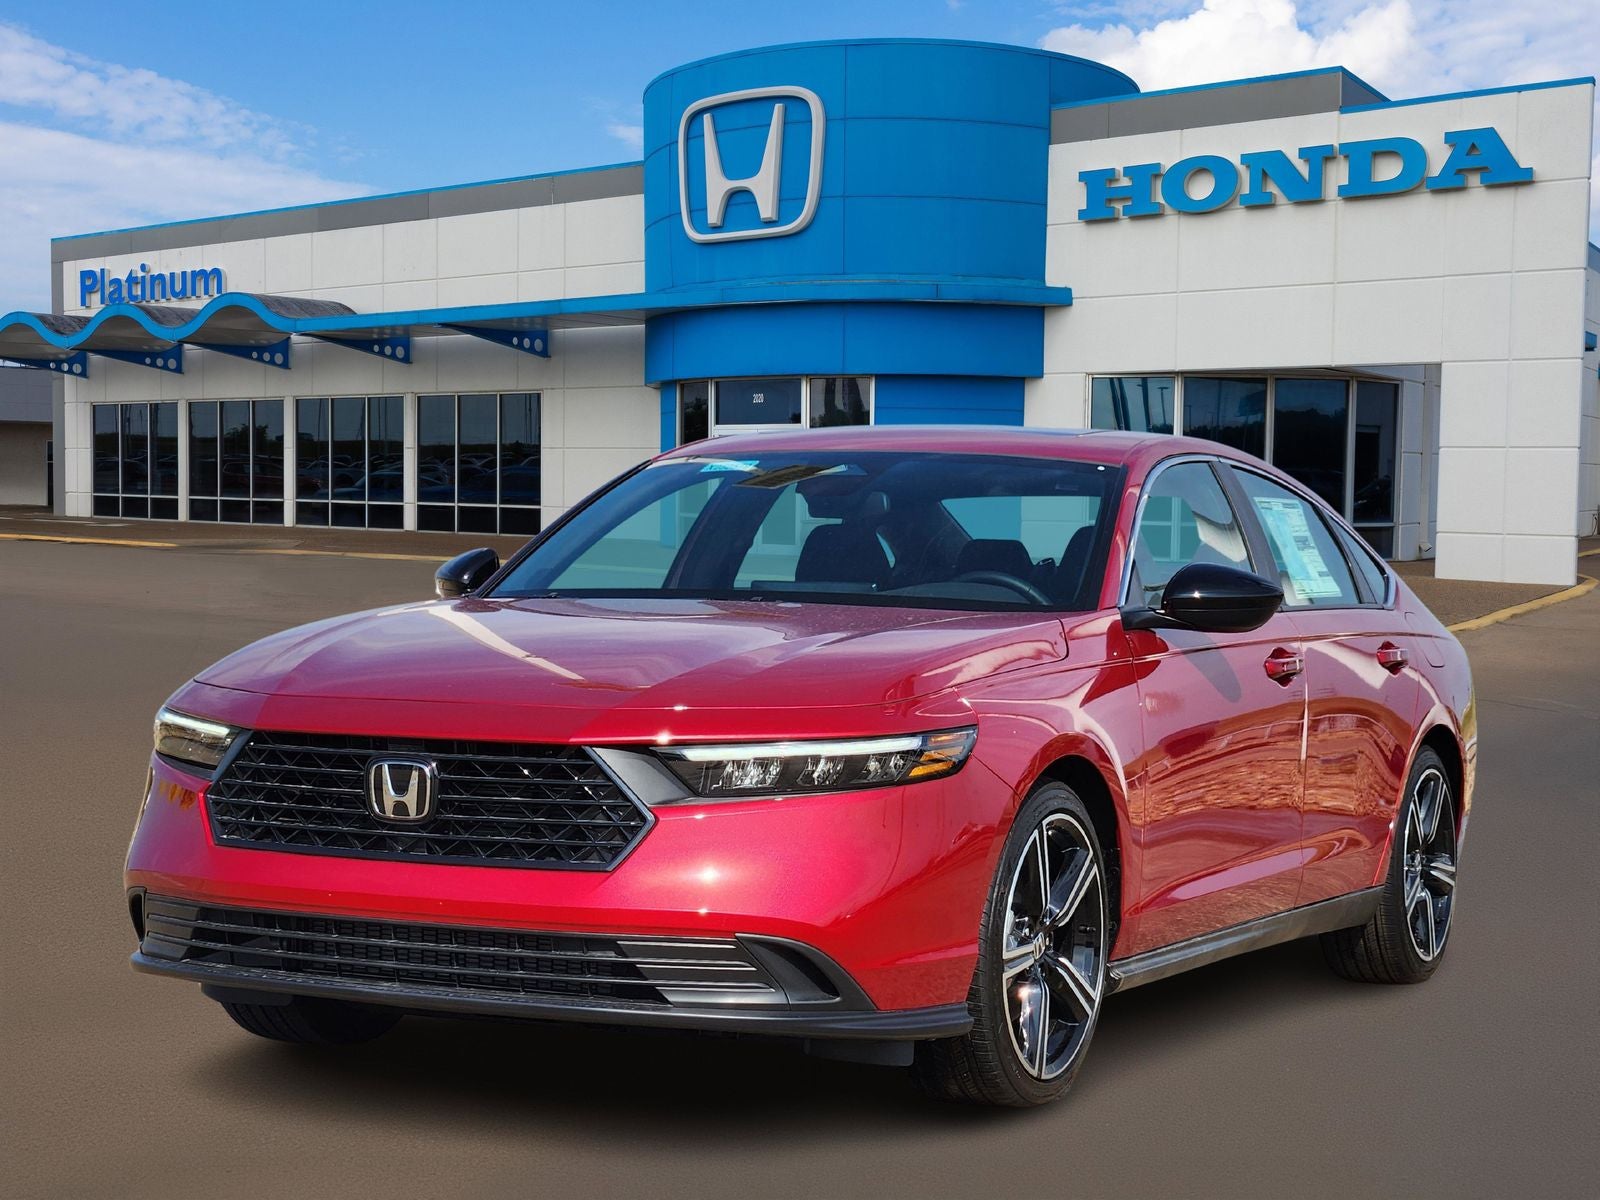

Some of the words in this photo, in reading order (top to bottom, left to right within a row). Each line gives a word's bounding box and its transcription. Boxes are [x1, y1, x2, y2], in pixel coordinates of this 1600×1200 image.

[703, 103, 785, 228] H
[1077, 126, 1535, 223] HONDA
[79, 262, 225, 308] Platinum
[381, 763, 419, 817] H
